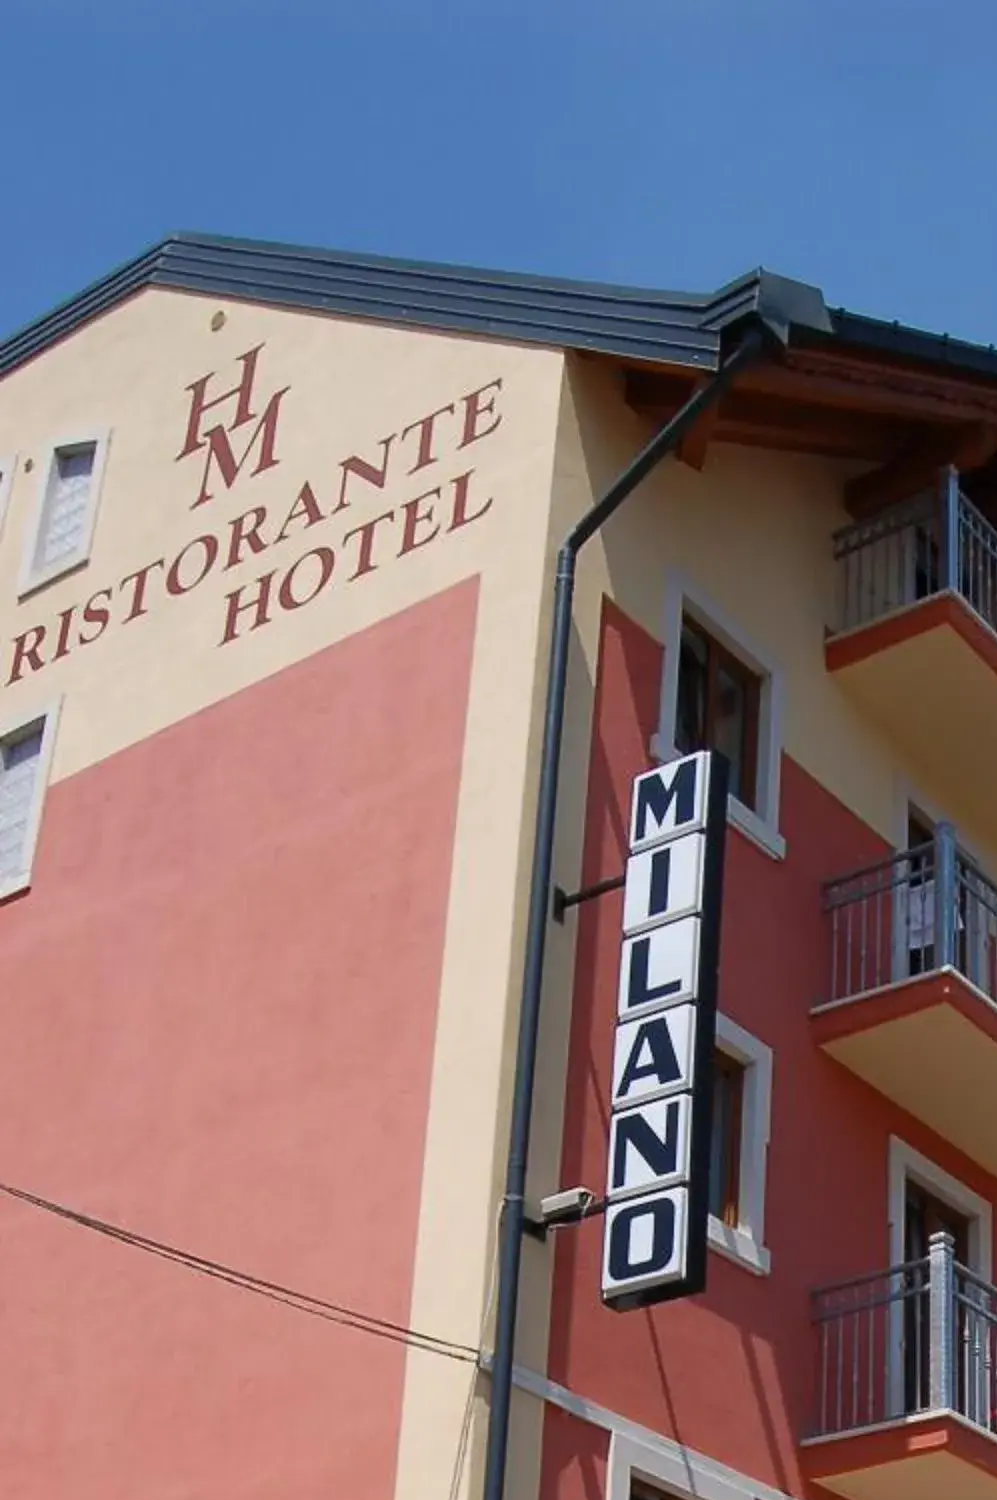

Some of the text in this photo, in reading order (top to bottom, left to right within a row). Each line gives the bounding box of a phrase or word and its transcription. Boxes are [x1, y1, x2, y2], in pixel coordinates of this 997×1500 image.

[4, 378, 504, 687] RISTORANTE
[217, 469, 494, 647] HOTEL
[609, 757, 697, 1281] MILANO
